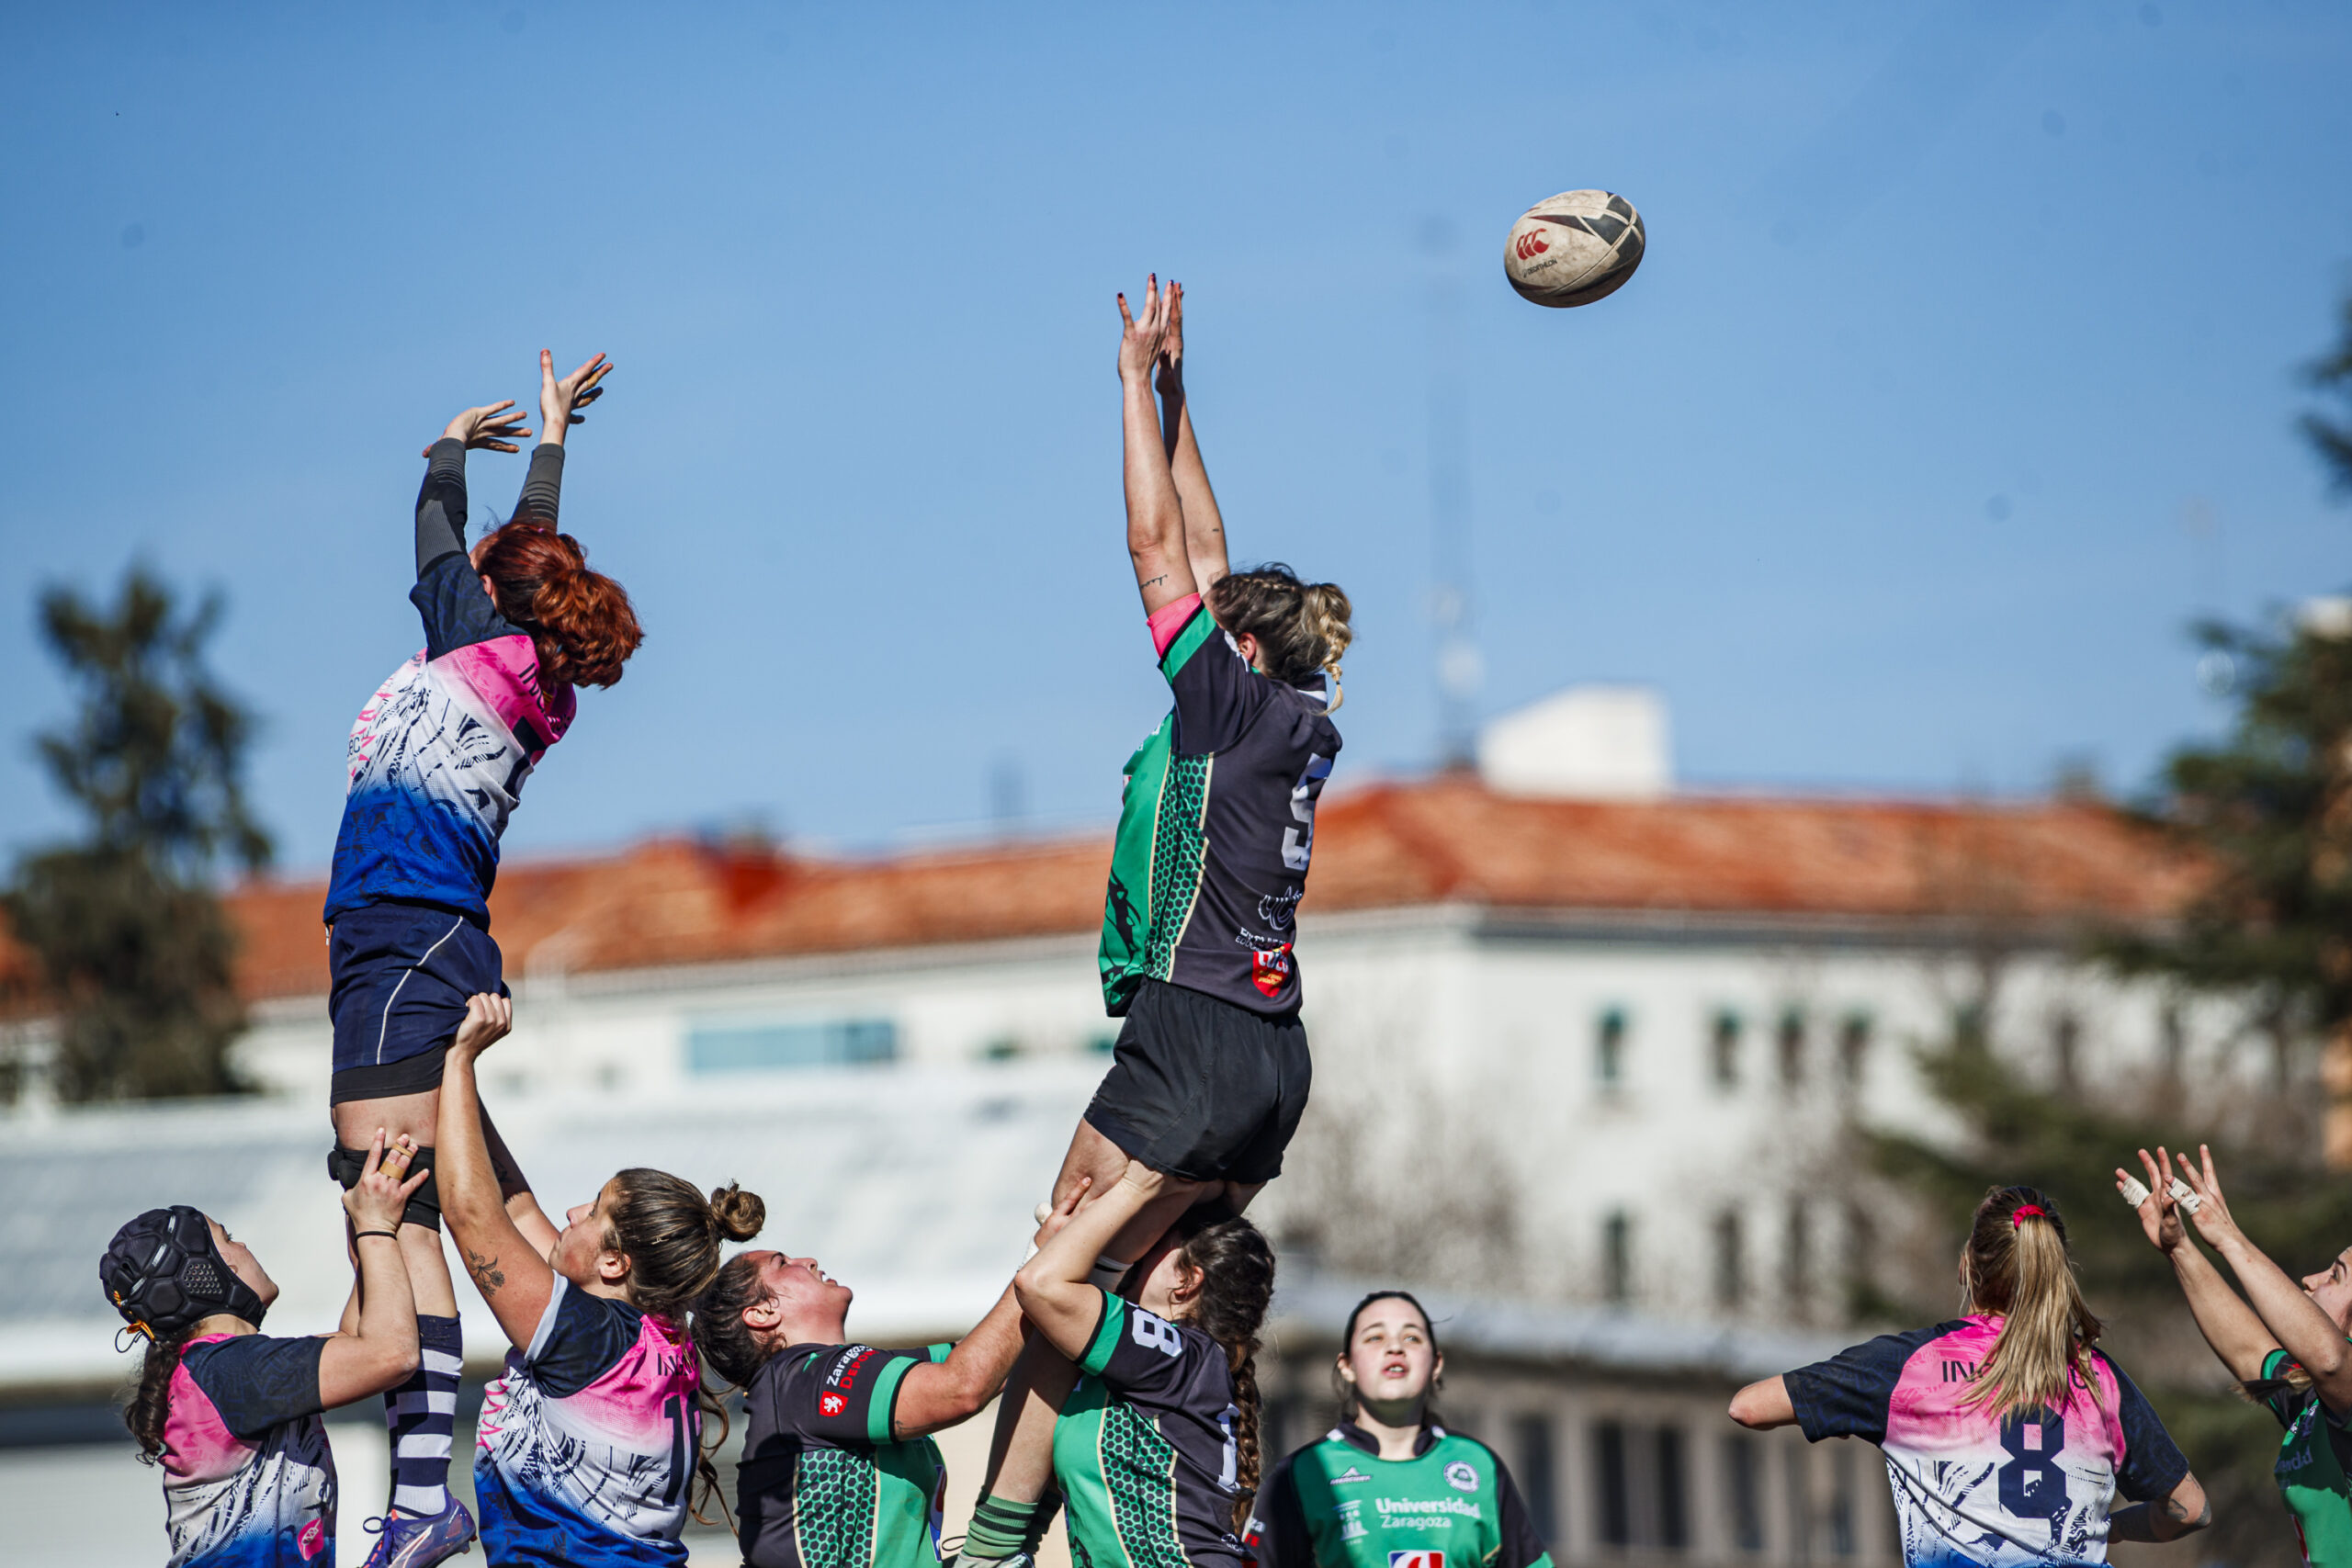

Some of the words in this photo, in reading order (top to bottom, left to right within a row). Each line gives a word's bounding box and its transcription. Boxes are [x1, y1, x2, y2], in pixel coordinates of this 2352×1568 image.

[1132, 1308, 1182, 1358] 8
[839, 1349, 879, 1389] DEPO
[1997, 1404, 2066, 1519] 8
[1374, 1496, 1481, 1519] Universidad
[1379, 1514, 1453, 1531] Zaragoza
